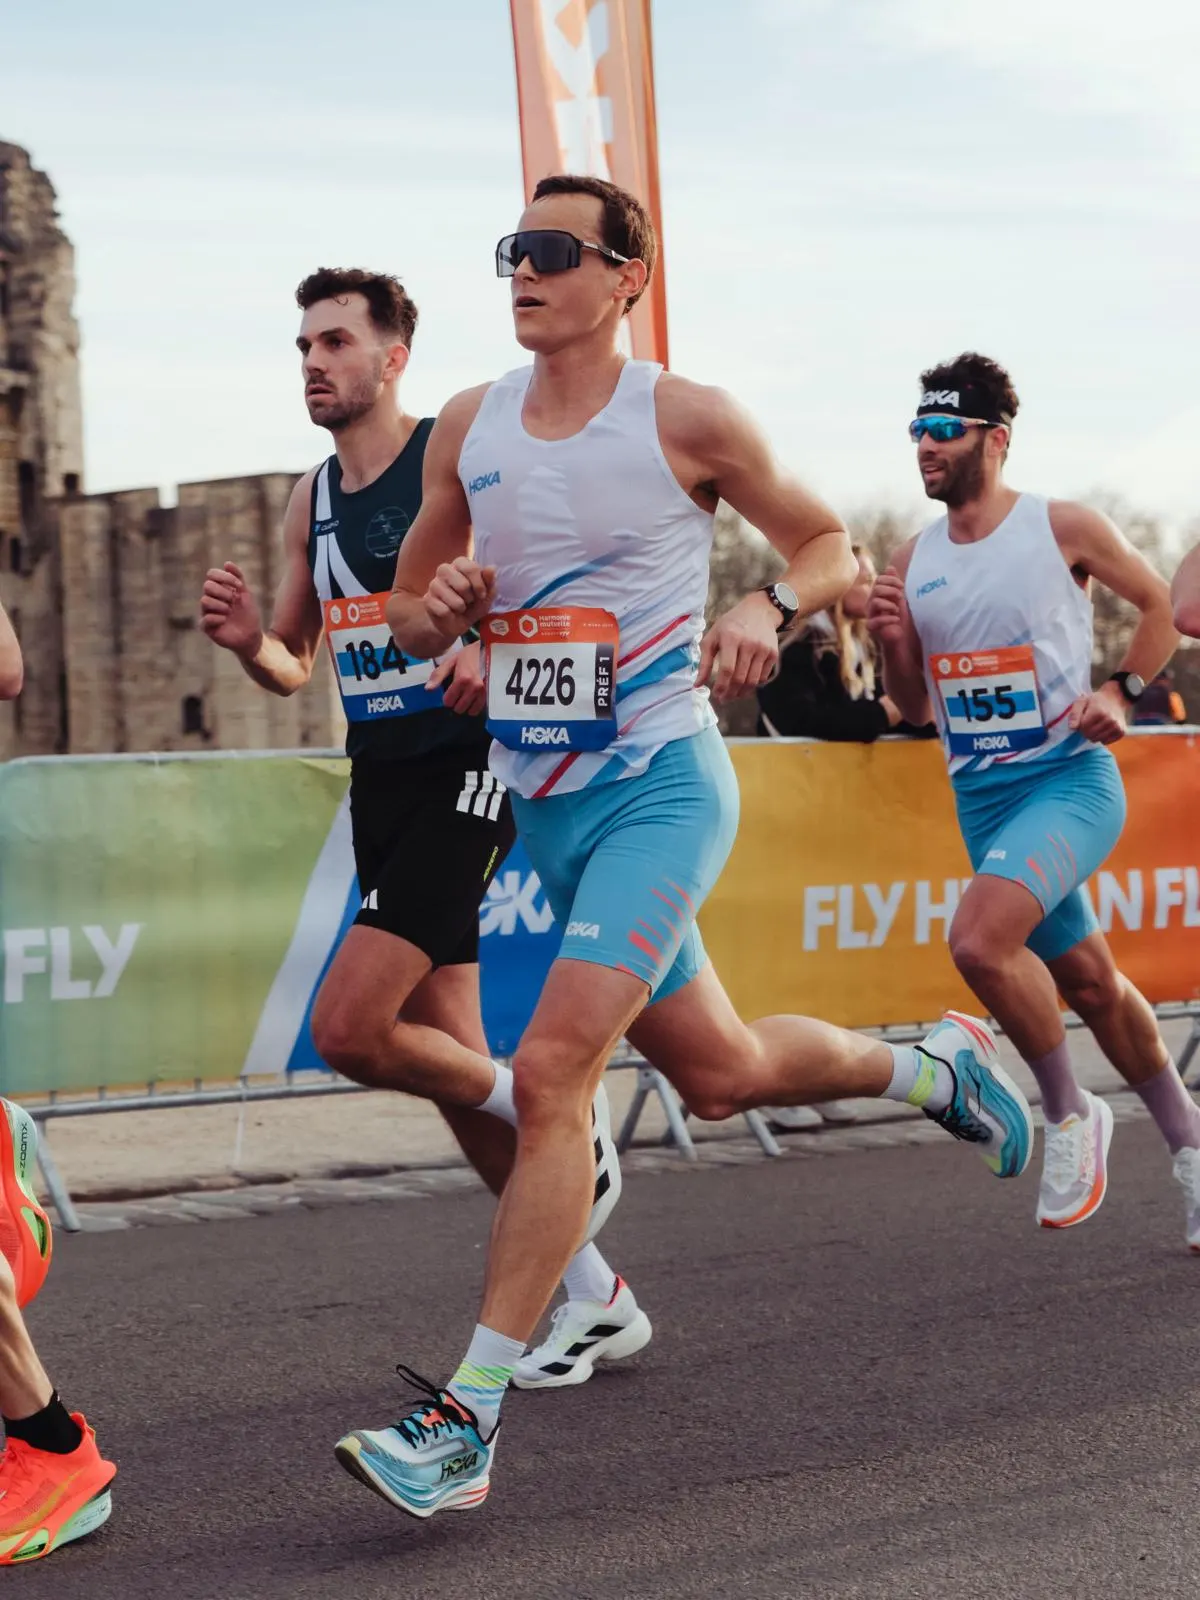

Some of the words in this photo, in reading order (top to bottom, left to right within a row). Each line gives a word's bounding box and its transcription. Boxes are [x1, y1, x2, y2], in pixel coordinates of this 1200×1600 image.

[468, 470, 501, 496] HOKA
[345, 636, 409, 681] 184
[505, 657, 576, 706] 4226
[367, 695, 404, 714] HOKA
[957, 685, 1017, 723] 155
[521, 726, 570, 744] HOKA
[973, 735, 1012, 751] HOKA
[802, 880, 908, 952] FLY
[4, 922, 143, 1004] FLY
[439, 1451, 479, 1481] HOKA
